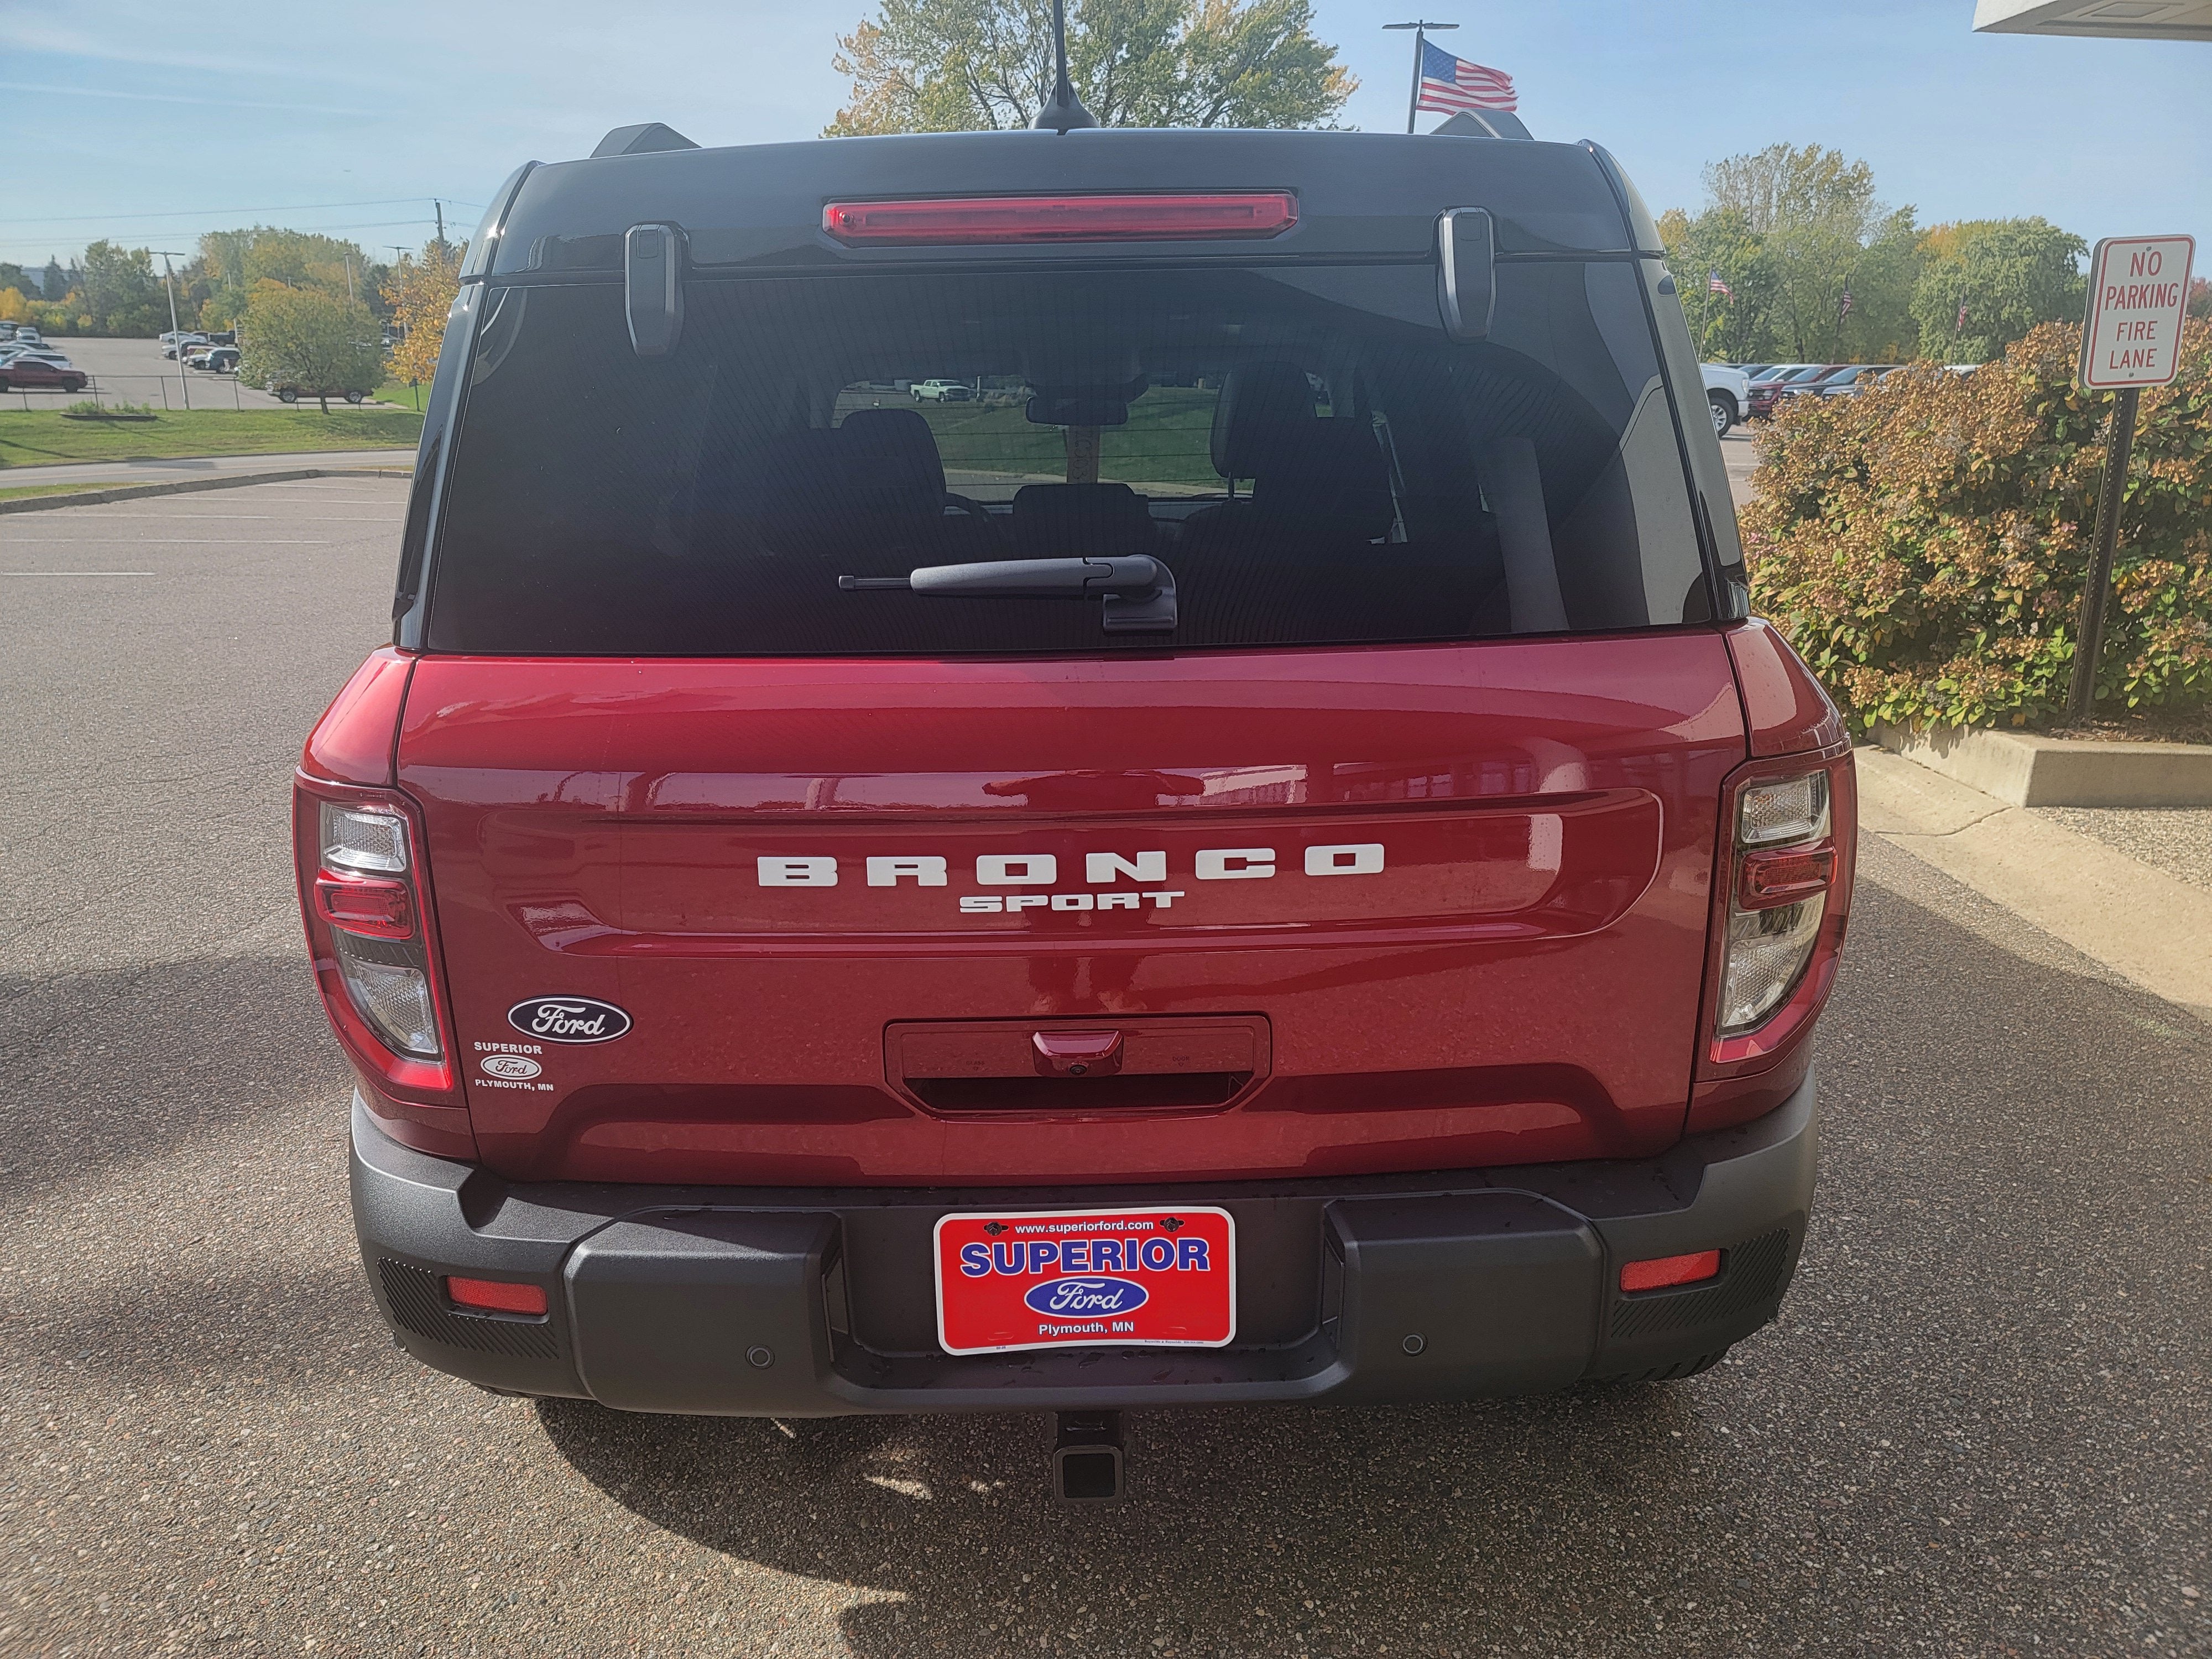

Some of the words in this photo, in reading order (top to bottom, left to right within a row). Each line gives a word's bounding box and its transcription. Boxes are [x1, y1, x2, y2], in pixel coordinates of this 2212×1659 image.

[2130, 251, 2162, 276] NO
[2105, 283, 2178, 310] PARKING
[2116, 321, 2158, 341] FIRE
[2109, 348, 2157, 369] LANE
[757, 843, 1385, 886] BRONCO
[959, 891, 1185, 914] SPORT
[531, 1004, 606, 1035] Ford
[474, 1041, 542, 1054] SUPERIOR
[495, 1060, 528, 1075] Ford
[474, 1079, 535, 1092] PLYMOUTH,
[538, 1083, 554, 1091] MN
[1015, 1220, 1154, 1234] www.superiorford.com
[960, 1237, 1211, 1278] SUPERIOR
[1050, 1282, 1124, 1310] Ford
[1039, 1322, 1108, 1337] Plymouth,
[1112, 1322, 1134, 1333] MN
